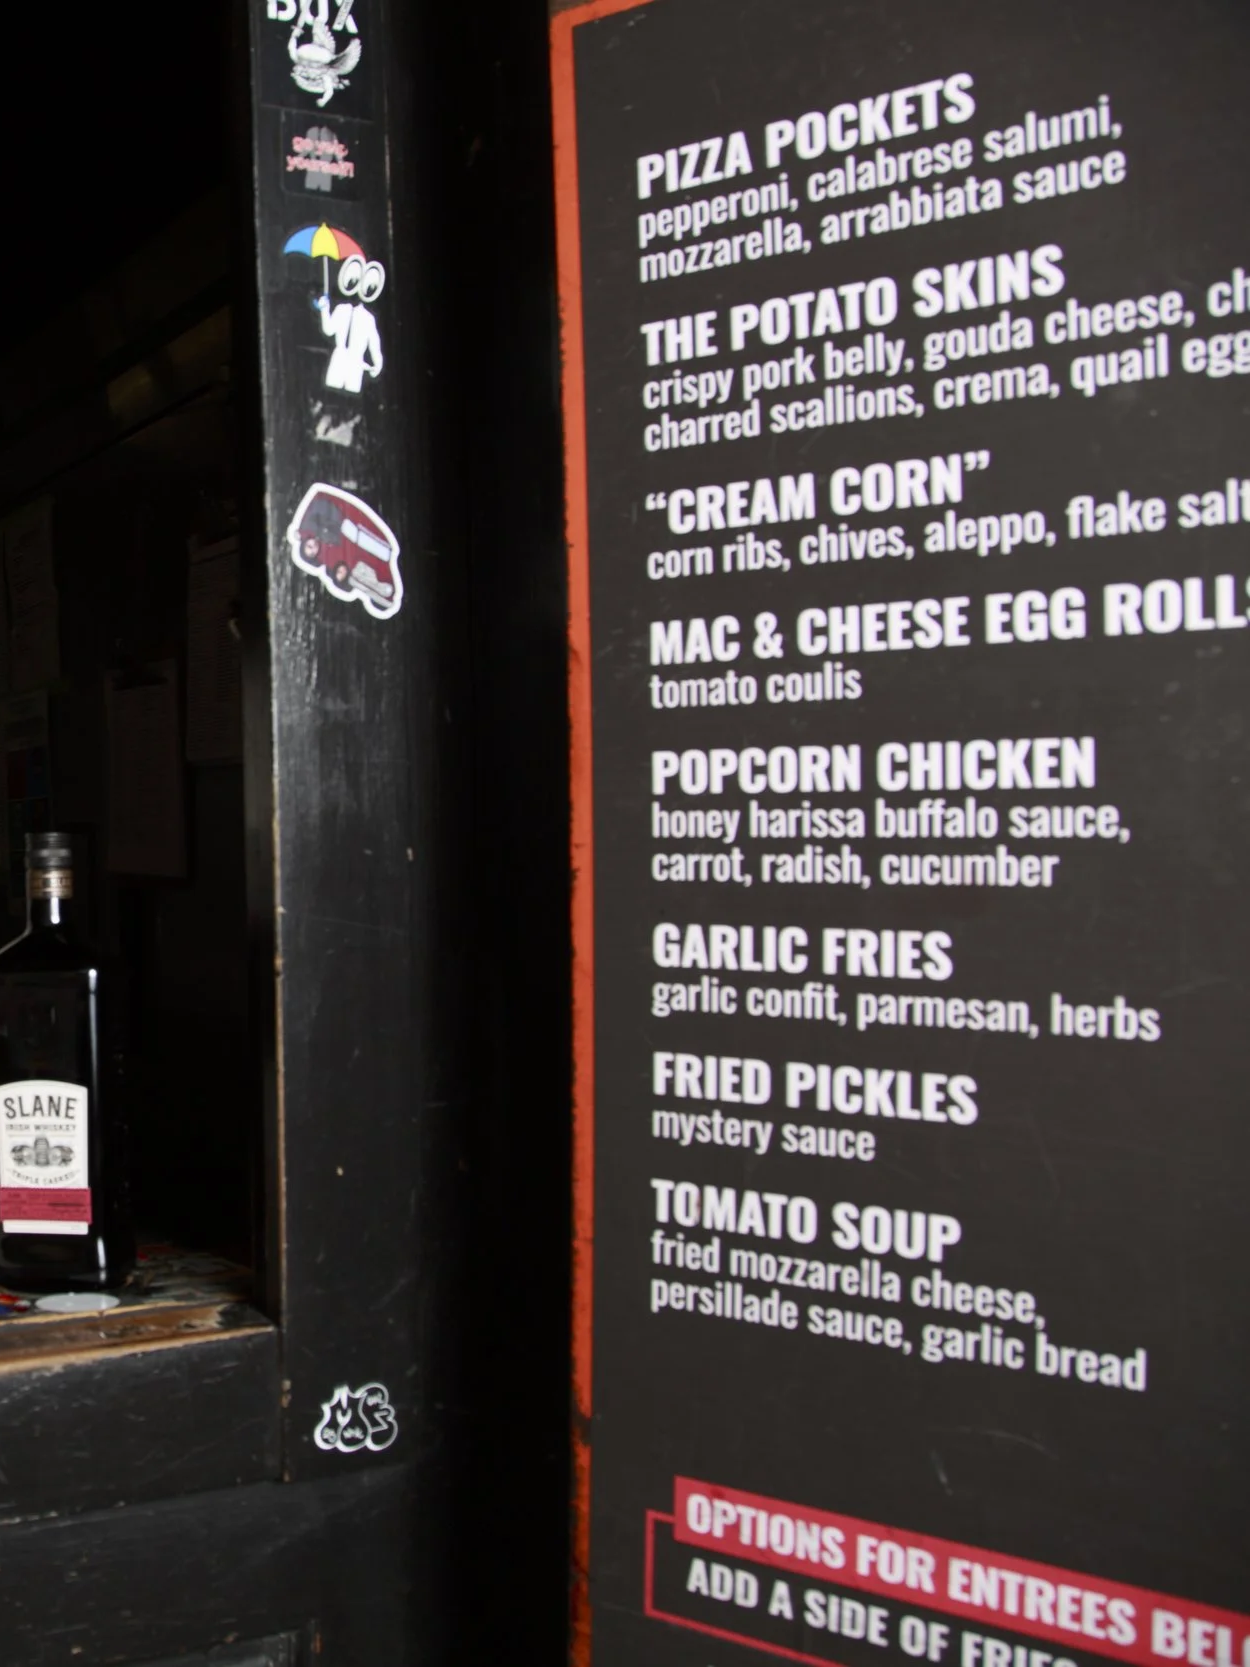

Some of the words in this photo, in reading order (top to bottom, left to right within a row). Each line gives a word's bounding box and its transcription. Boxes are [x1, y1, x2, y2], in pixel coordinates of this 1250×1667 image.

[637, 131, 753, 200] PIZZA
[765, 72, 976, 169] POCKETS
[638, 172, 799, 249] pepperoni,
[807, 137, 973, 202] calabrese
[983, 94, 1122, 162] salumi,
[639, 216, 812, 283] mozzarella,
[820, 175, 1003, 245] arrabbiata
[1013, 150, 1126, 204] sauce
[640, 310, 718, 367] THE
[730, 276, 898, 351] POTATO
[912, 244, 1065, 318] SKINS
[643, 368, 734, 410] crispy
[742, 346, 816, 401] pork
[823, 331, 914, 381] belly,
[923, 309, 1034, 372] gouda
[1044, 290, 1195, 345] cheese,
[644, 398, 761, 452] charred
[769, 384, 924, 434] scallions,
[933, 363, 1060, 410] crema,
[1070, 332, 1169, 398] quail
[647, 546, 714, 580] corn
[722, 531, 791, 573] ribs,
[799, 523, 915, 565] chives,
[924, 509, 1056, 557] aleppo,
[1065, 490, 1167, 540] flake
[650, 615, 741, 666] MAC
[752, 611, 784, 660] &
[796, 596, 971, 657] CHEESE
[984, 586, 1087, 645] EGG
[1103, 574, 1250, 637] ROLL
[649, 669, 758, 709] tomato
[766, 660, 863, 704] coulis
[651, 744, 861, 796] POPCORN
[876, 736, 1095, 792] CHICKEN
[652, 801, 741, 844] honey
[749, 799, 866, 839] harissa
[875, 796, 999, 839] buffalo
[1009, 804, 1130, 843] sauce,
[652, 847, 752, 887] carrot,
[761, 844, 871, 890] radish,
[880, 844, 1060, 888] cucumber
[653, 922, 808, 974] GARLIC
[822, 927, 953, 981] FRIES
[651, 975, 737, 1018] garlic
[746, 981, 847, 1026] confit,
[857, 993, 1039, 1039] parmesan,
[1051, 993, 1161, 1042] herbs
[3, 1095, 77, 1119] SLANE
[653, 1051, 771, 1105] FRIED
[786, 1061, 978, 1125] PICKLES
[652, 1109, 773, 1155] mystery
[782, 1123, 876, 1162] sauce
[650, 1178, 818, 1244] TOMATO
[832, 1202, 962, 1263] SOUP
[651, 1229, 720, 1273] fried
[730, 1249, 901, 1302] mozzarella
[911, 1269, 1045, 1330] cheese,
[651, 1279, 798, 1330] persillade
[808, 1305, 912, 1355] sauce,
[921, 1323, 1024, 1369] garlic
[1036, 1332, 1146, 1391] bread
[686, 1493, 846, 1569] OPTIONS
[856, 1534, 936, 1594] FOR
[947, 1557, 1136, 1645] ENTREES
[687, 1558, 758, 1608] ADD
[769, 1580, 793, 1620] A
[804, 1589, 889, 1646] SIDE
[900, 1616, 949, 1661] OF
